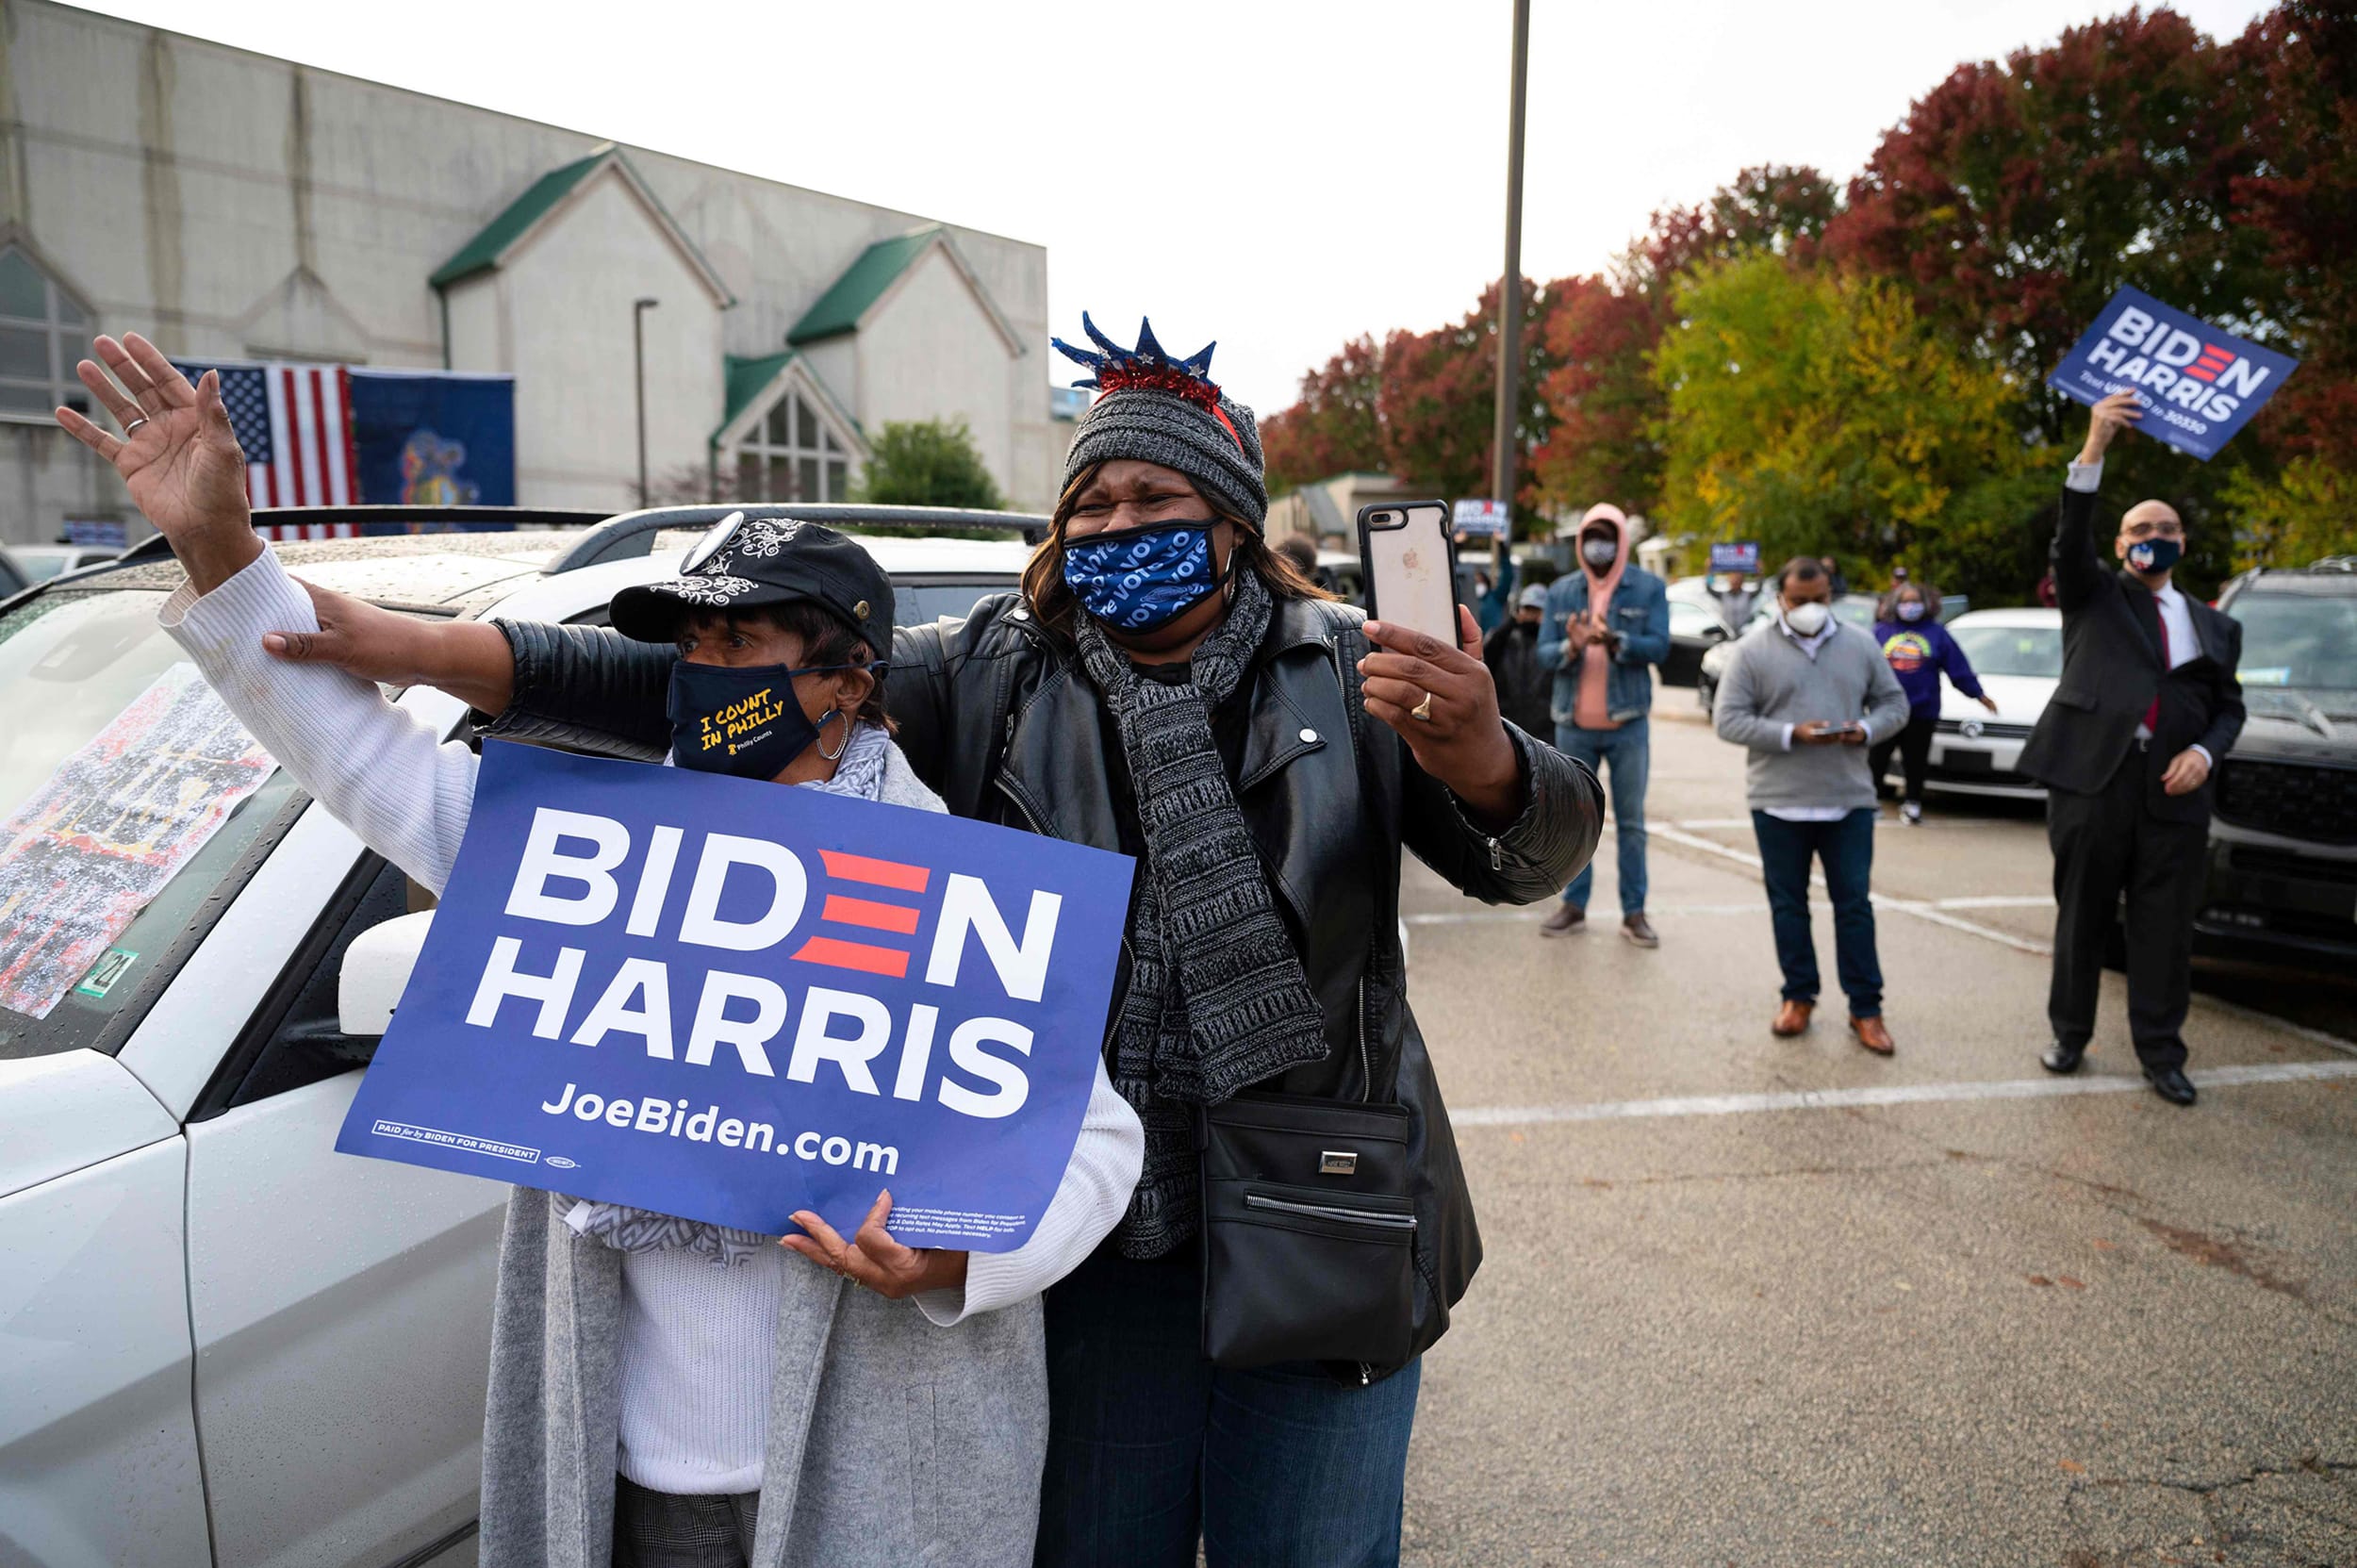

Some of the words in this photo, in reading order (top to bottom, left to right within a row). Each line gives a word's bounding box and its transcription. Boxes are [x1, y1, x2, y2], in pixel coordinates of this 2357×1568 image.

[2086, 338, 2240, 422] HARRIS
[2108, 305, 2271, 400] BIDEN
[701, 717, 712, 733] I
[716, 688, 771, 724] COUNT
[701, 731, 722, 751] IN
[727, 701, 783, 739] PHILLY
[736, 739, 753, 751] Philly
[753, 730, 772, 743] Counts
[504, 806, 1063, 1003] BIDEN
[465, 935, 1034, 1119] HARRIS
[378, 1124, 402, 1133] PAID
[400, 1128, 413, 1136] for
[413, 1130, 423, 1139] by
[424, 1131, 455, 1144] BIDEN
[456, 1137, 478, 1148] FOR
[479, 1144, 536, 1159] PRESIDENT
[541, 1083, 898, 1175] JoeBiden.com
